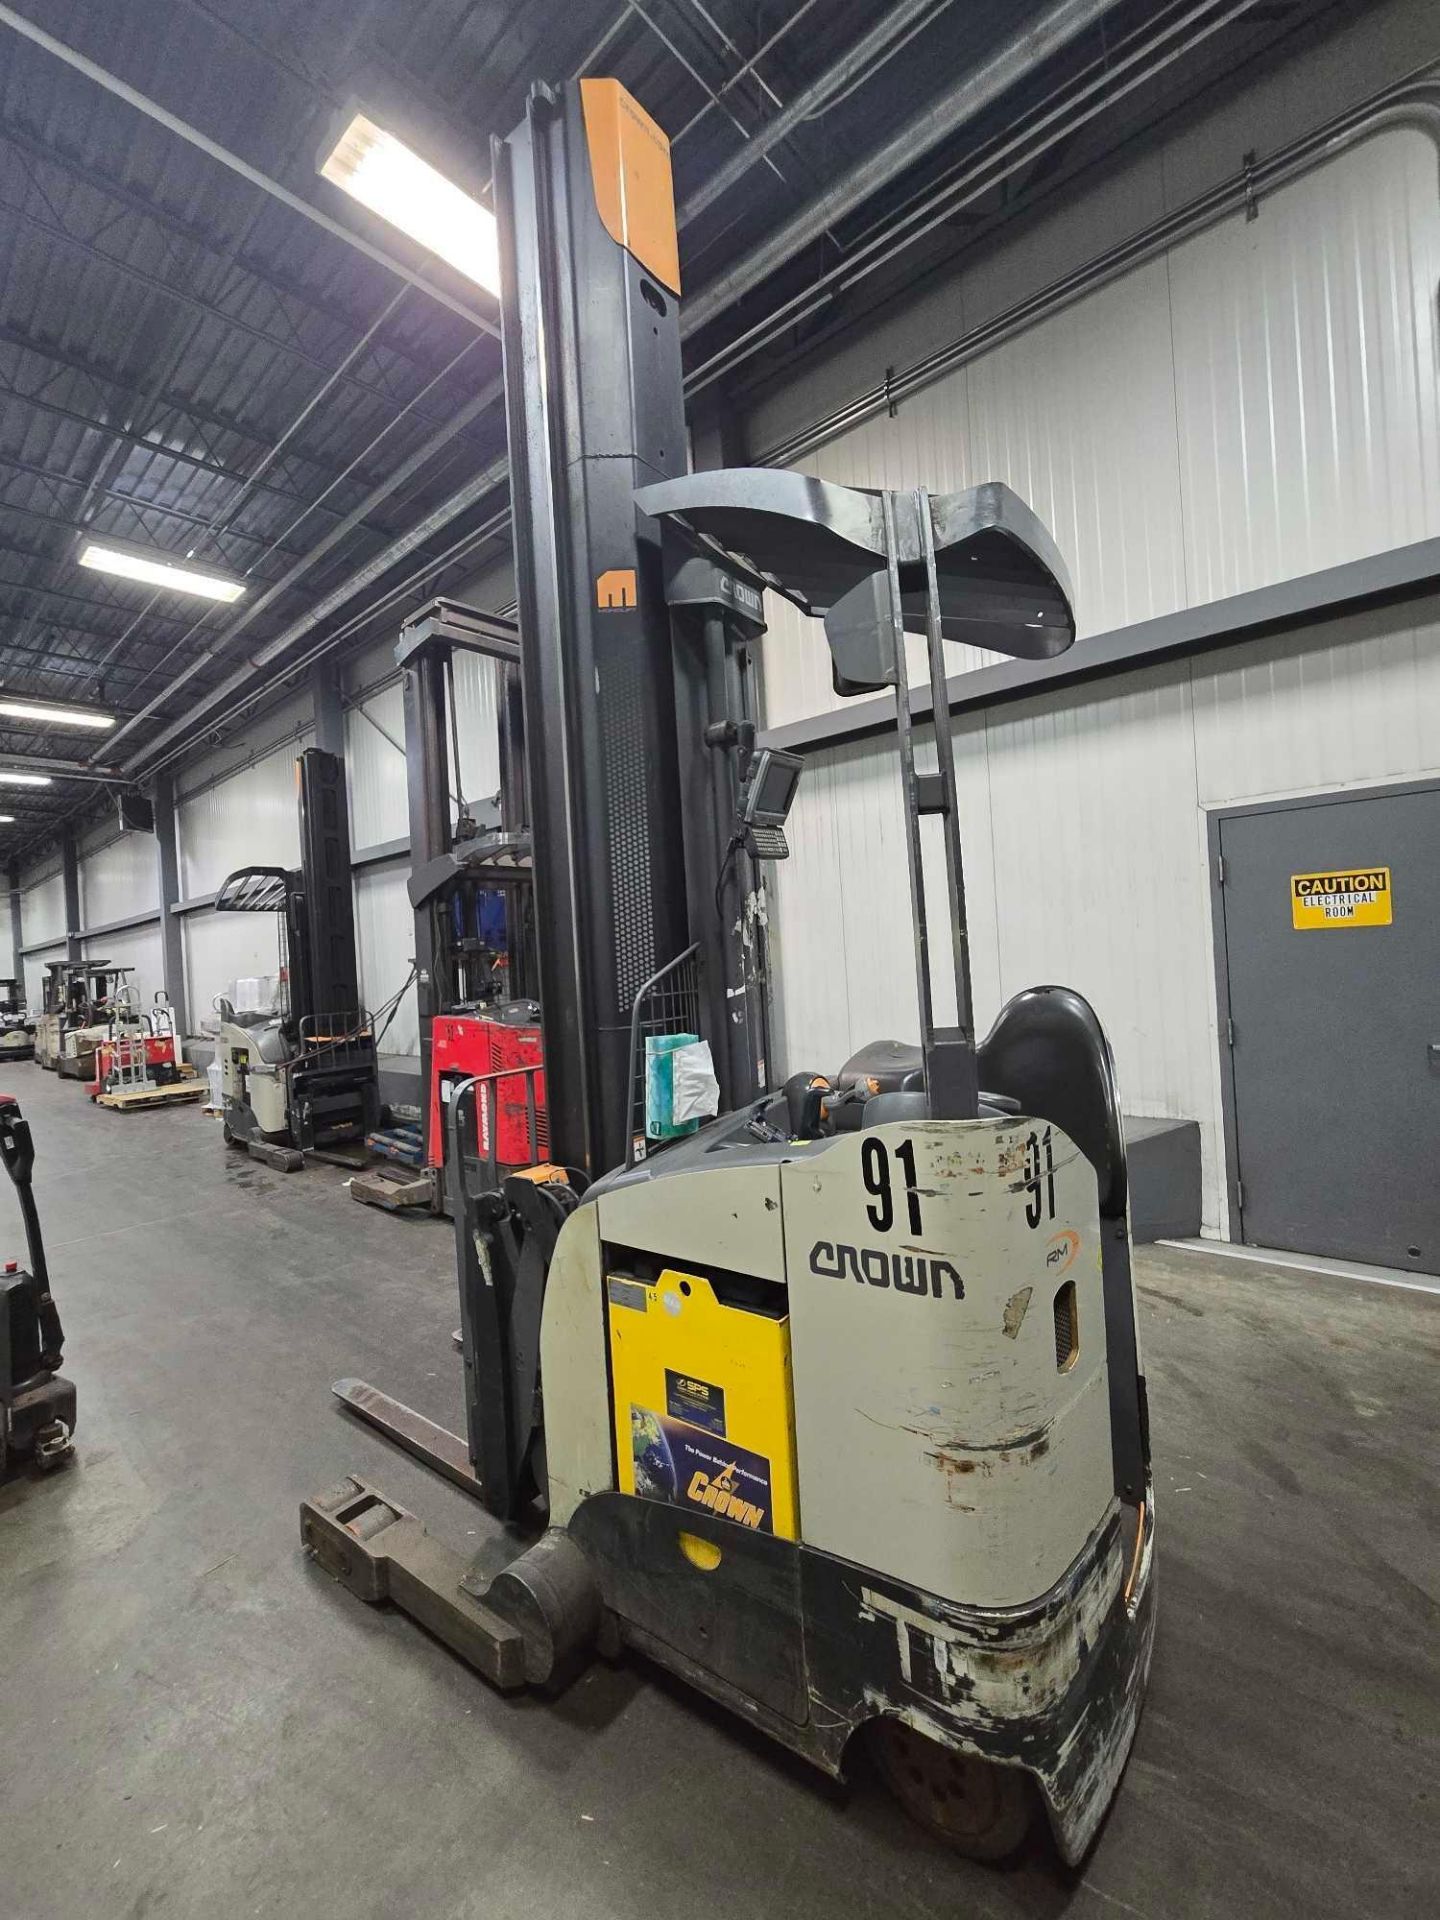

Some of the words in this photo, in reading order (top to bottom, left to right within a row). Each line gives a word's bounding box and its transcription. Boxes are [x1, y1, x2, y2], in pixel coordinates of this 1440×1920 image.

[1297, 874, 1383, 895] CAUTION
[1303, 892, 1375, 907] ELECTRICAL
[1325, 906, 1354, 918] ROOM
[480, 1083, 489, 1151] RAYMOND
[861, 1137, 922, 1236] 91
[1024, 1125, 1055, 1229] 91
[1046, 1243, 1068, 1268] RM
[809, 1240, 966, 1300] CROWN
[687, 1381, 709, 1396] SPS
[684, 1444, 695, 1454] The
[687, 1471, 765, 1528] CROWN
